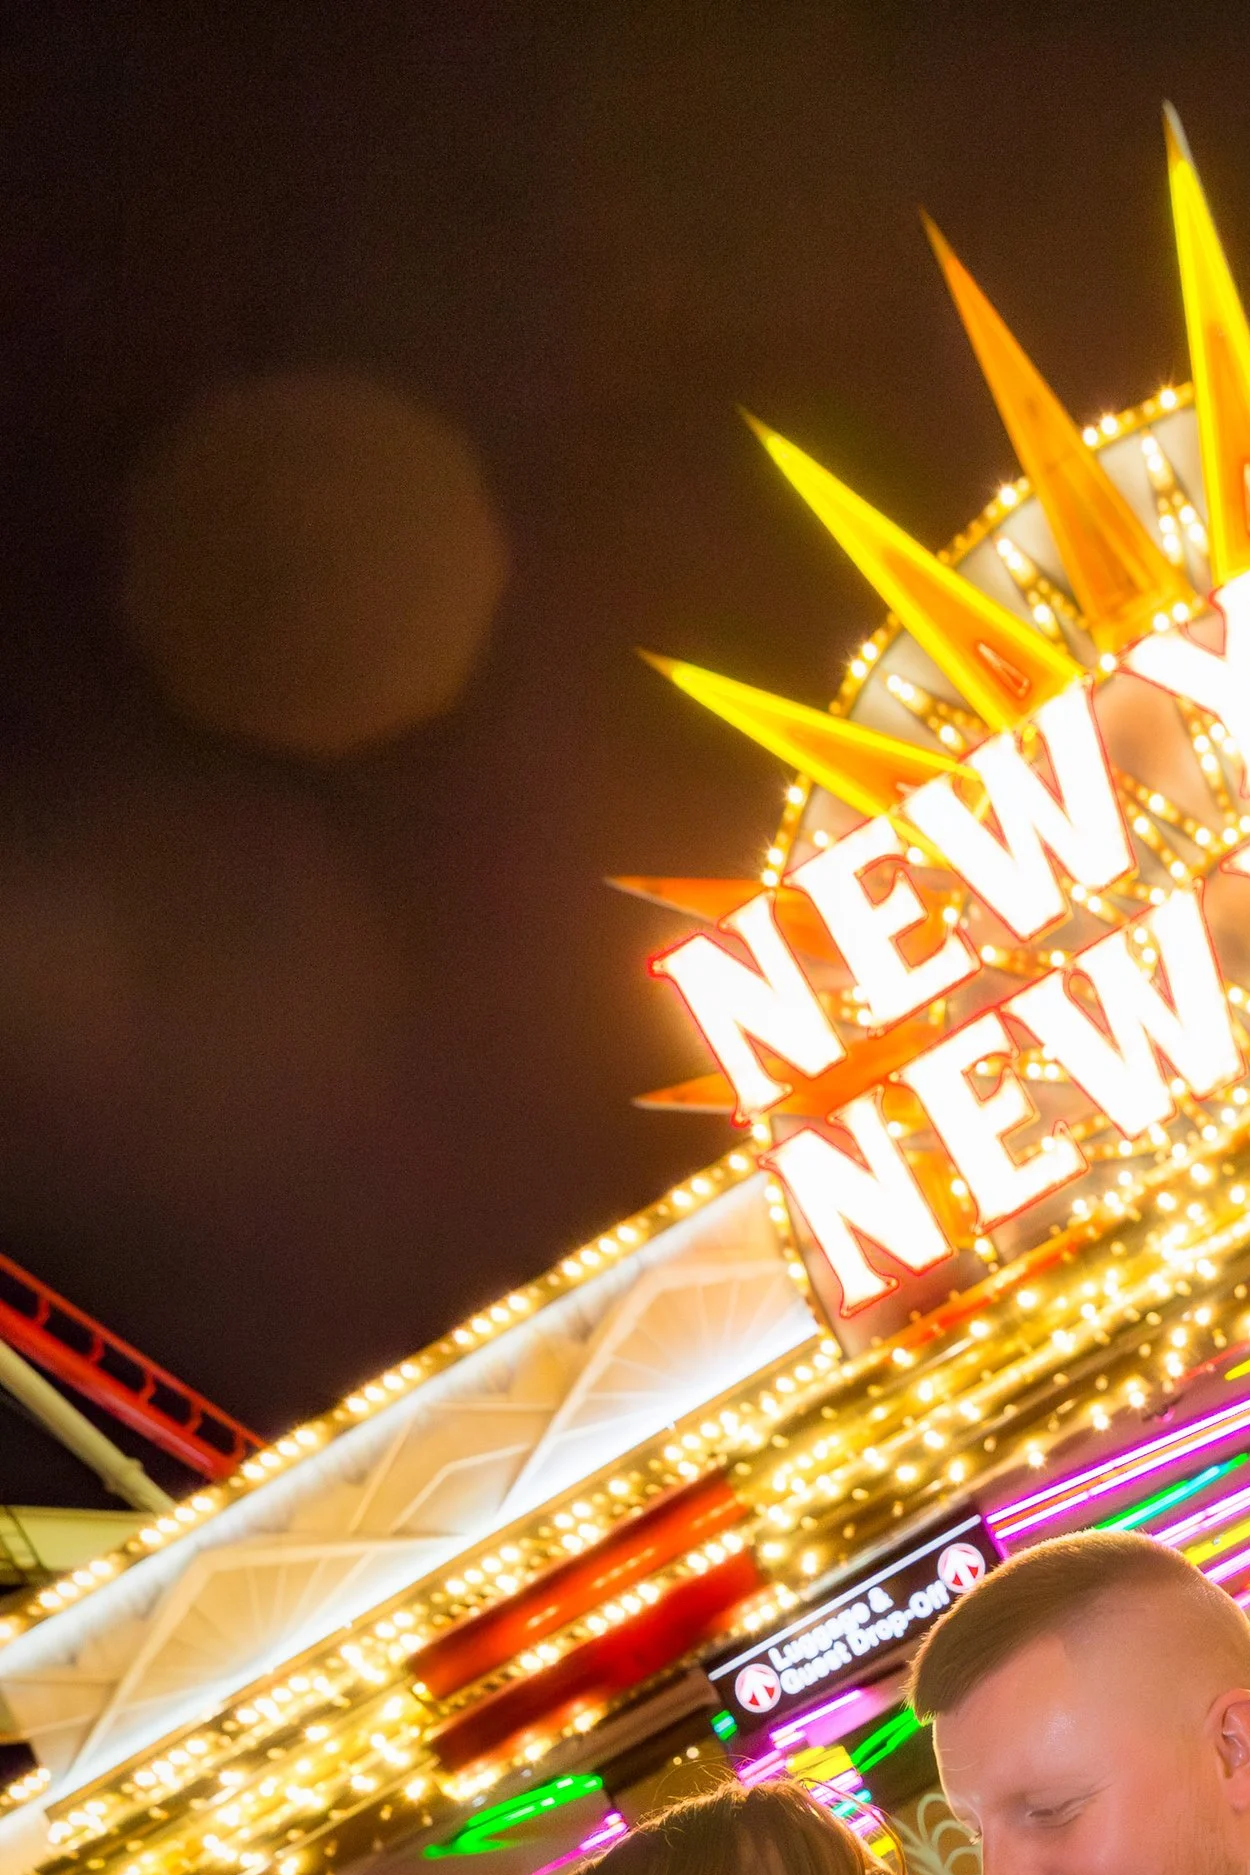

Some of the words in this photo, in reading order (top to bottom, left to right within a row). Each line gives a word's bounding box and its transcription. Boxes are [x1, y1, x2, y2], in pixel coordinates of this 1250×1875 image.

[650, 678, 1138, 1125] NEW
[762, 880, 1250, 1318] NEW
[768, 1602, 871, 1671] Luggage
[780, 1641, 852, 1694] Guest
[848, 1580, 950, 1656] Drop-Off
